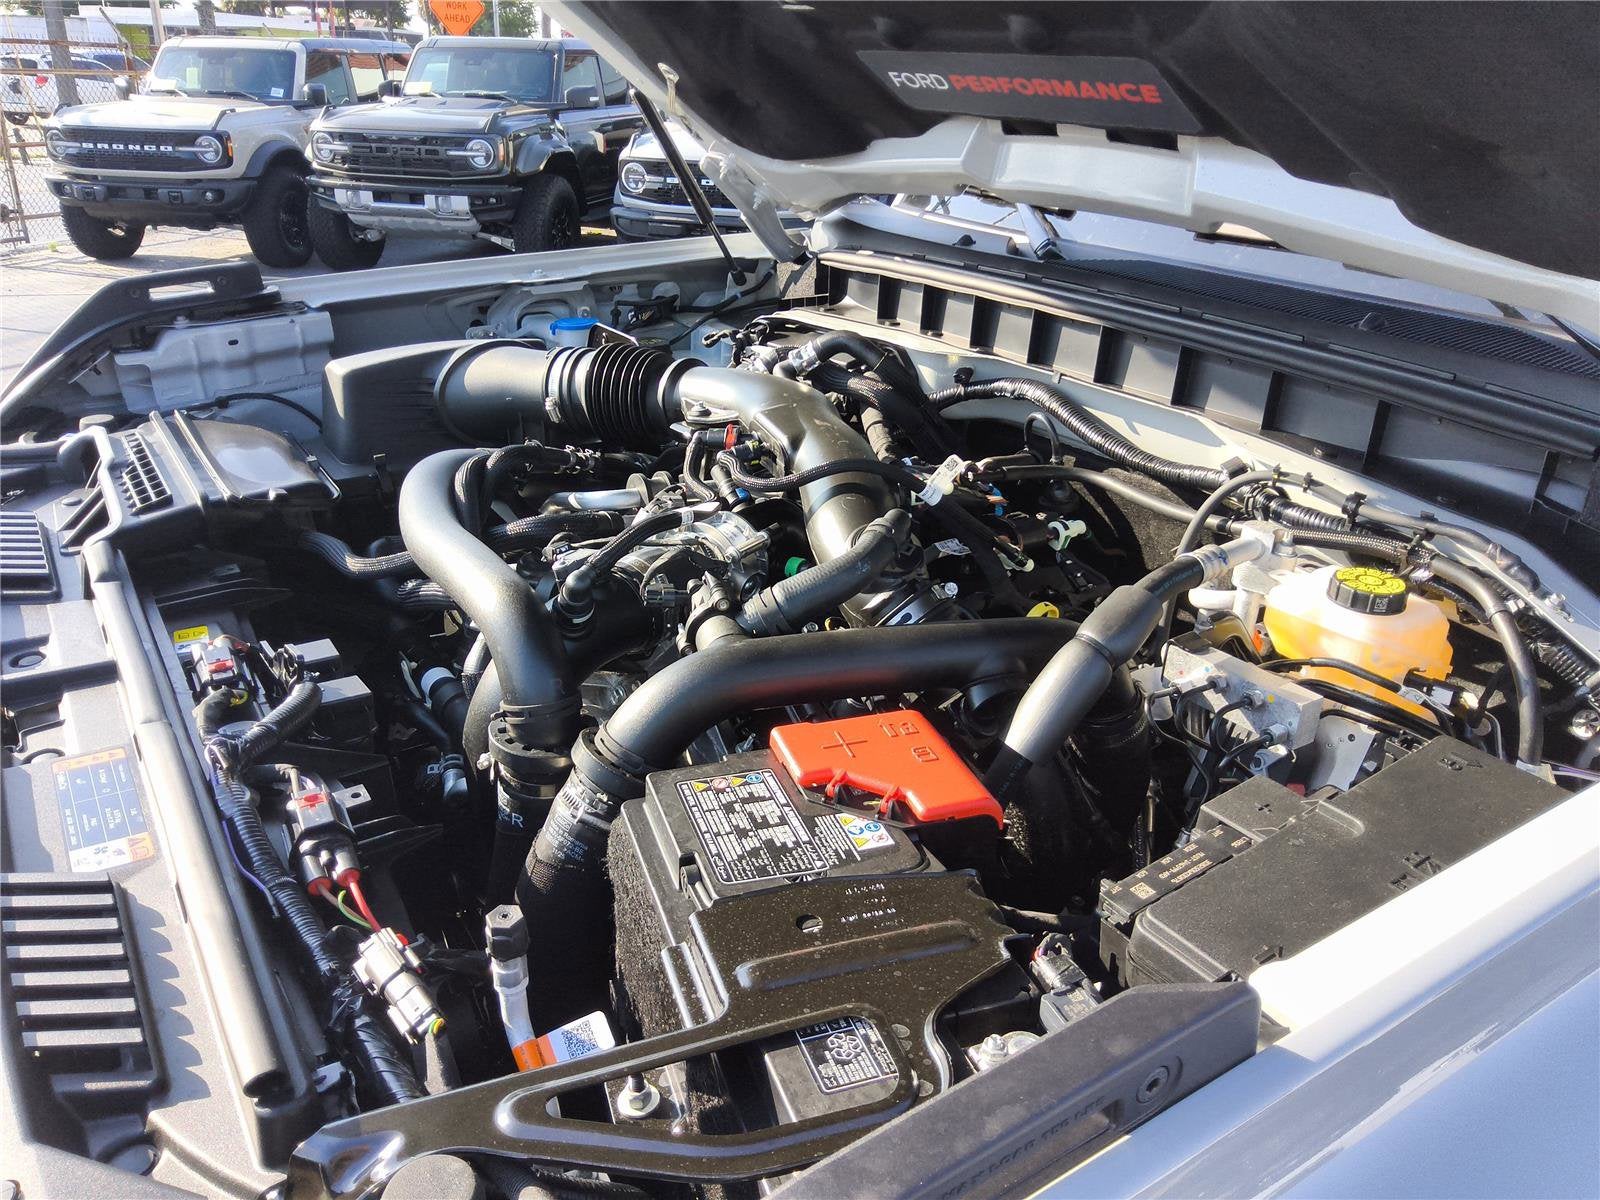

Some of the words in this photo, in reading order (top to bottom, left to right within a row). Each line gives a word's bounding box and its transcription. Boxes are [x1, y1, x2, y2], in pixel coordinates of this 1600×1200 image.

[446, 1, 467, 11] WORK
[444, 13, 470, 24] AHEAD
[888, 71, 949, 90] FORD
[949, 74, 1162, 104] PERFORMANCE
[82, 142, 173, 152] BRONCO
[511, 812, 524, 828] R
